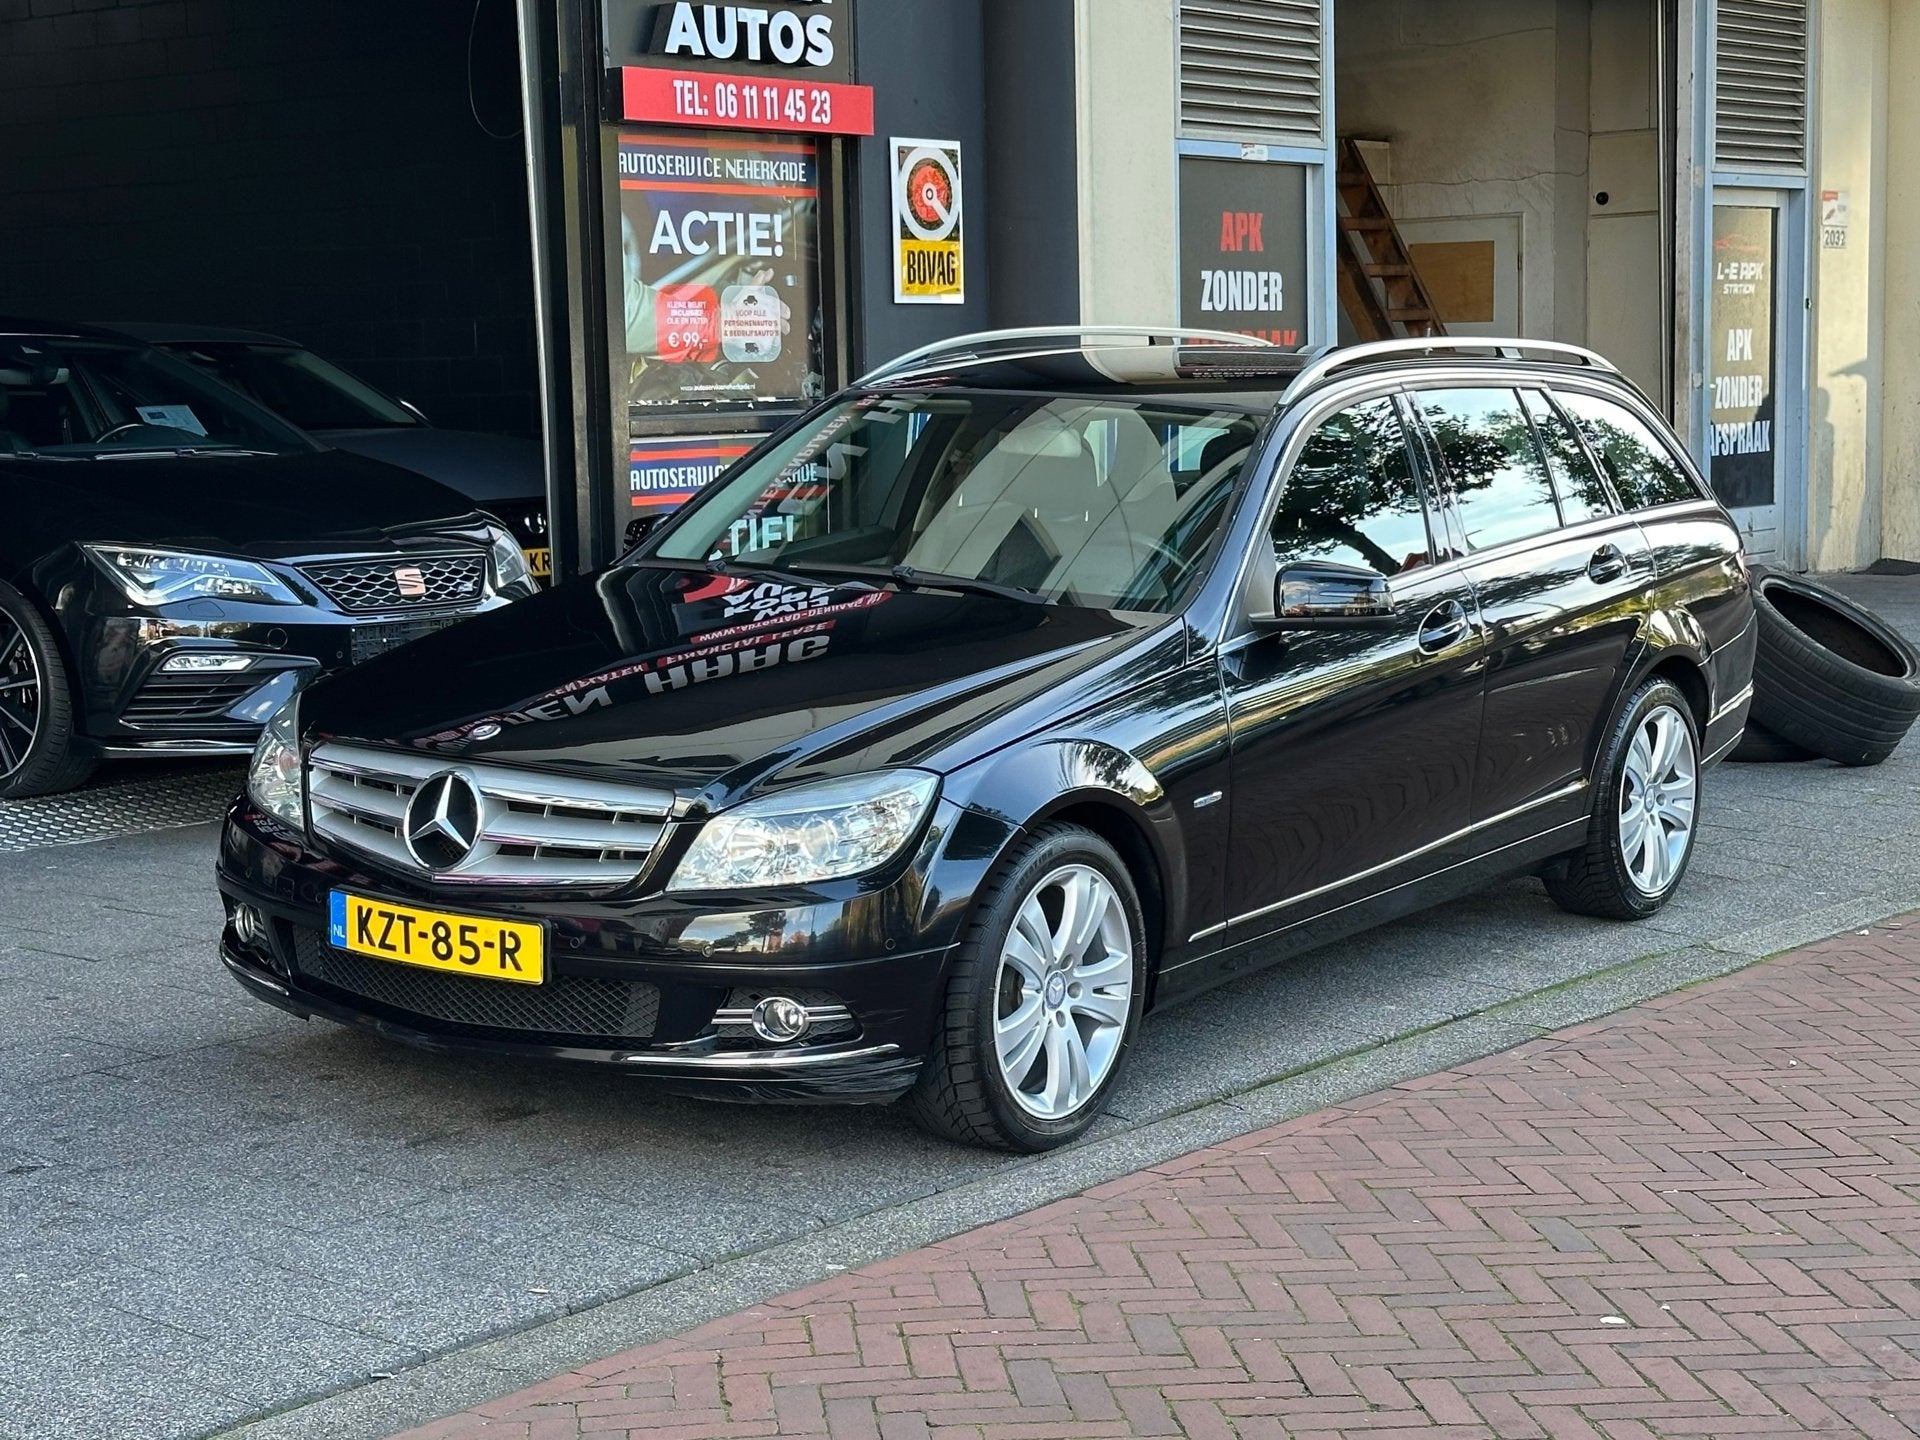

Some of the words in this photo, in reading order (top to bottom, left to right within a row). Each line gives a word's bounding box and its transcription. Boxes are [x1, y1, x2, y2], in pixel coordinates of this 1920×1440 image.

[665, 1, 834, 66] AUTOS
[673, 79, 709, 116] TEL:
[715, 82, 738, 118] 06
[742, 85, 759, 119] 11
[763, 86, 779, 121] 11
[784, 88, 806, 123] 45
[811, 89, 831, 124] 23
[619, 152, 722, 178] AUTOSERVICE
[726, 158, 807, 182] NEHERKADE
[649, 210, 784, 257] ACTIE!
[1220, 210, 1264, 252] APK
[907, 249, 956, 285] BOVAG
[1201, 270, 1283, 312] ZONDER
[668, 332, 680, 348] €
[683, 332, 708, 349] 99,-
[1727, 328, 1752, 361] APK
[1715, 375, 1763, 409] ZONDER
[1710, 420, 1771, 456] AFSPRAAK
[333, 925, 345, 939] NL
[357, 905, 522, 972] KZT-85-R
